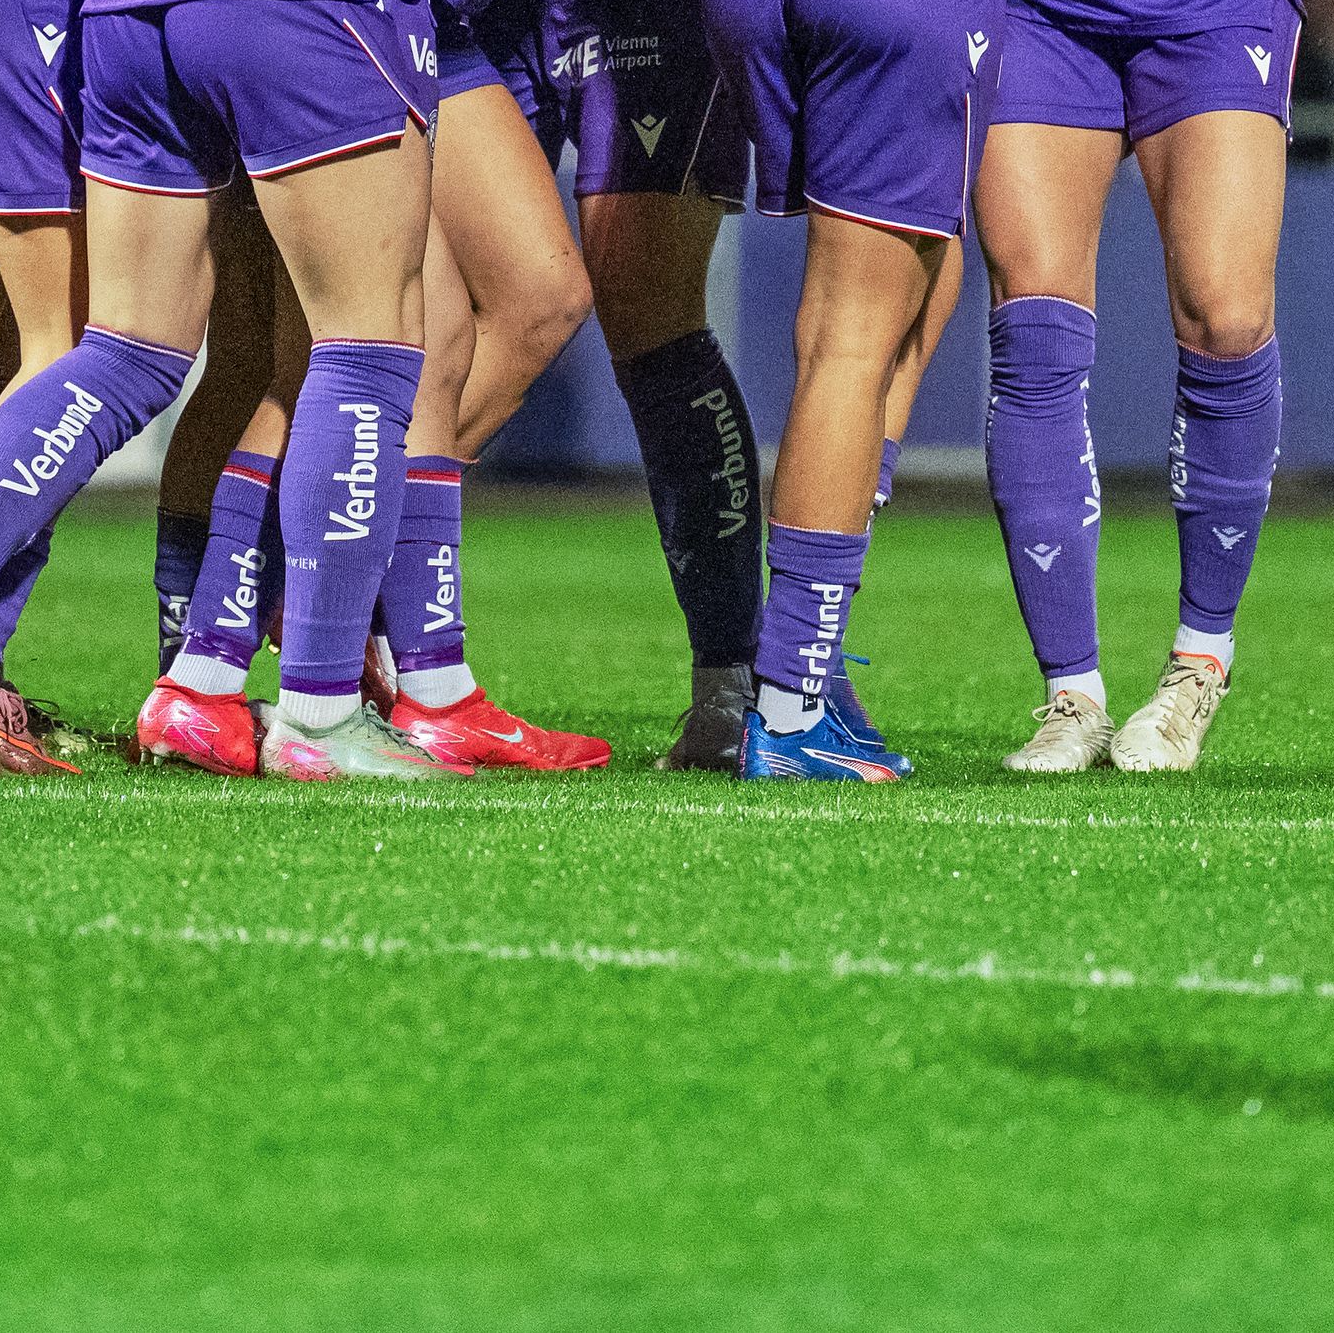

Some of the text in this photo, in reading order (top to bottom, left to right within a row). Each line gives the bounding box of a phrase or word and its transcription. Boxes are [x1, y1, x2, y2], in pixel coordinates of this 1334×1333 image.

[603, 54, 663, 72] Airport
[604, 36, 660, 53] Vienna
[323, 403, 382, 542] Verbund
[690, 388, 750, 539] Verbund
[424, 545, 453, 634] Verb
